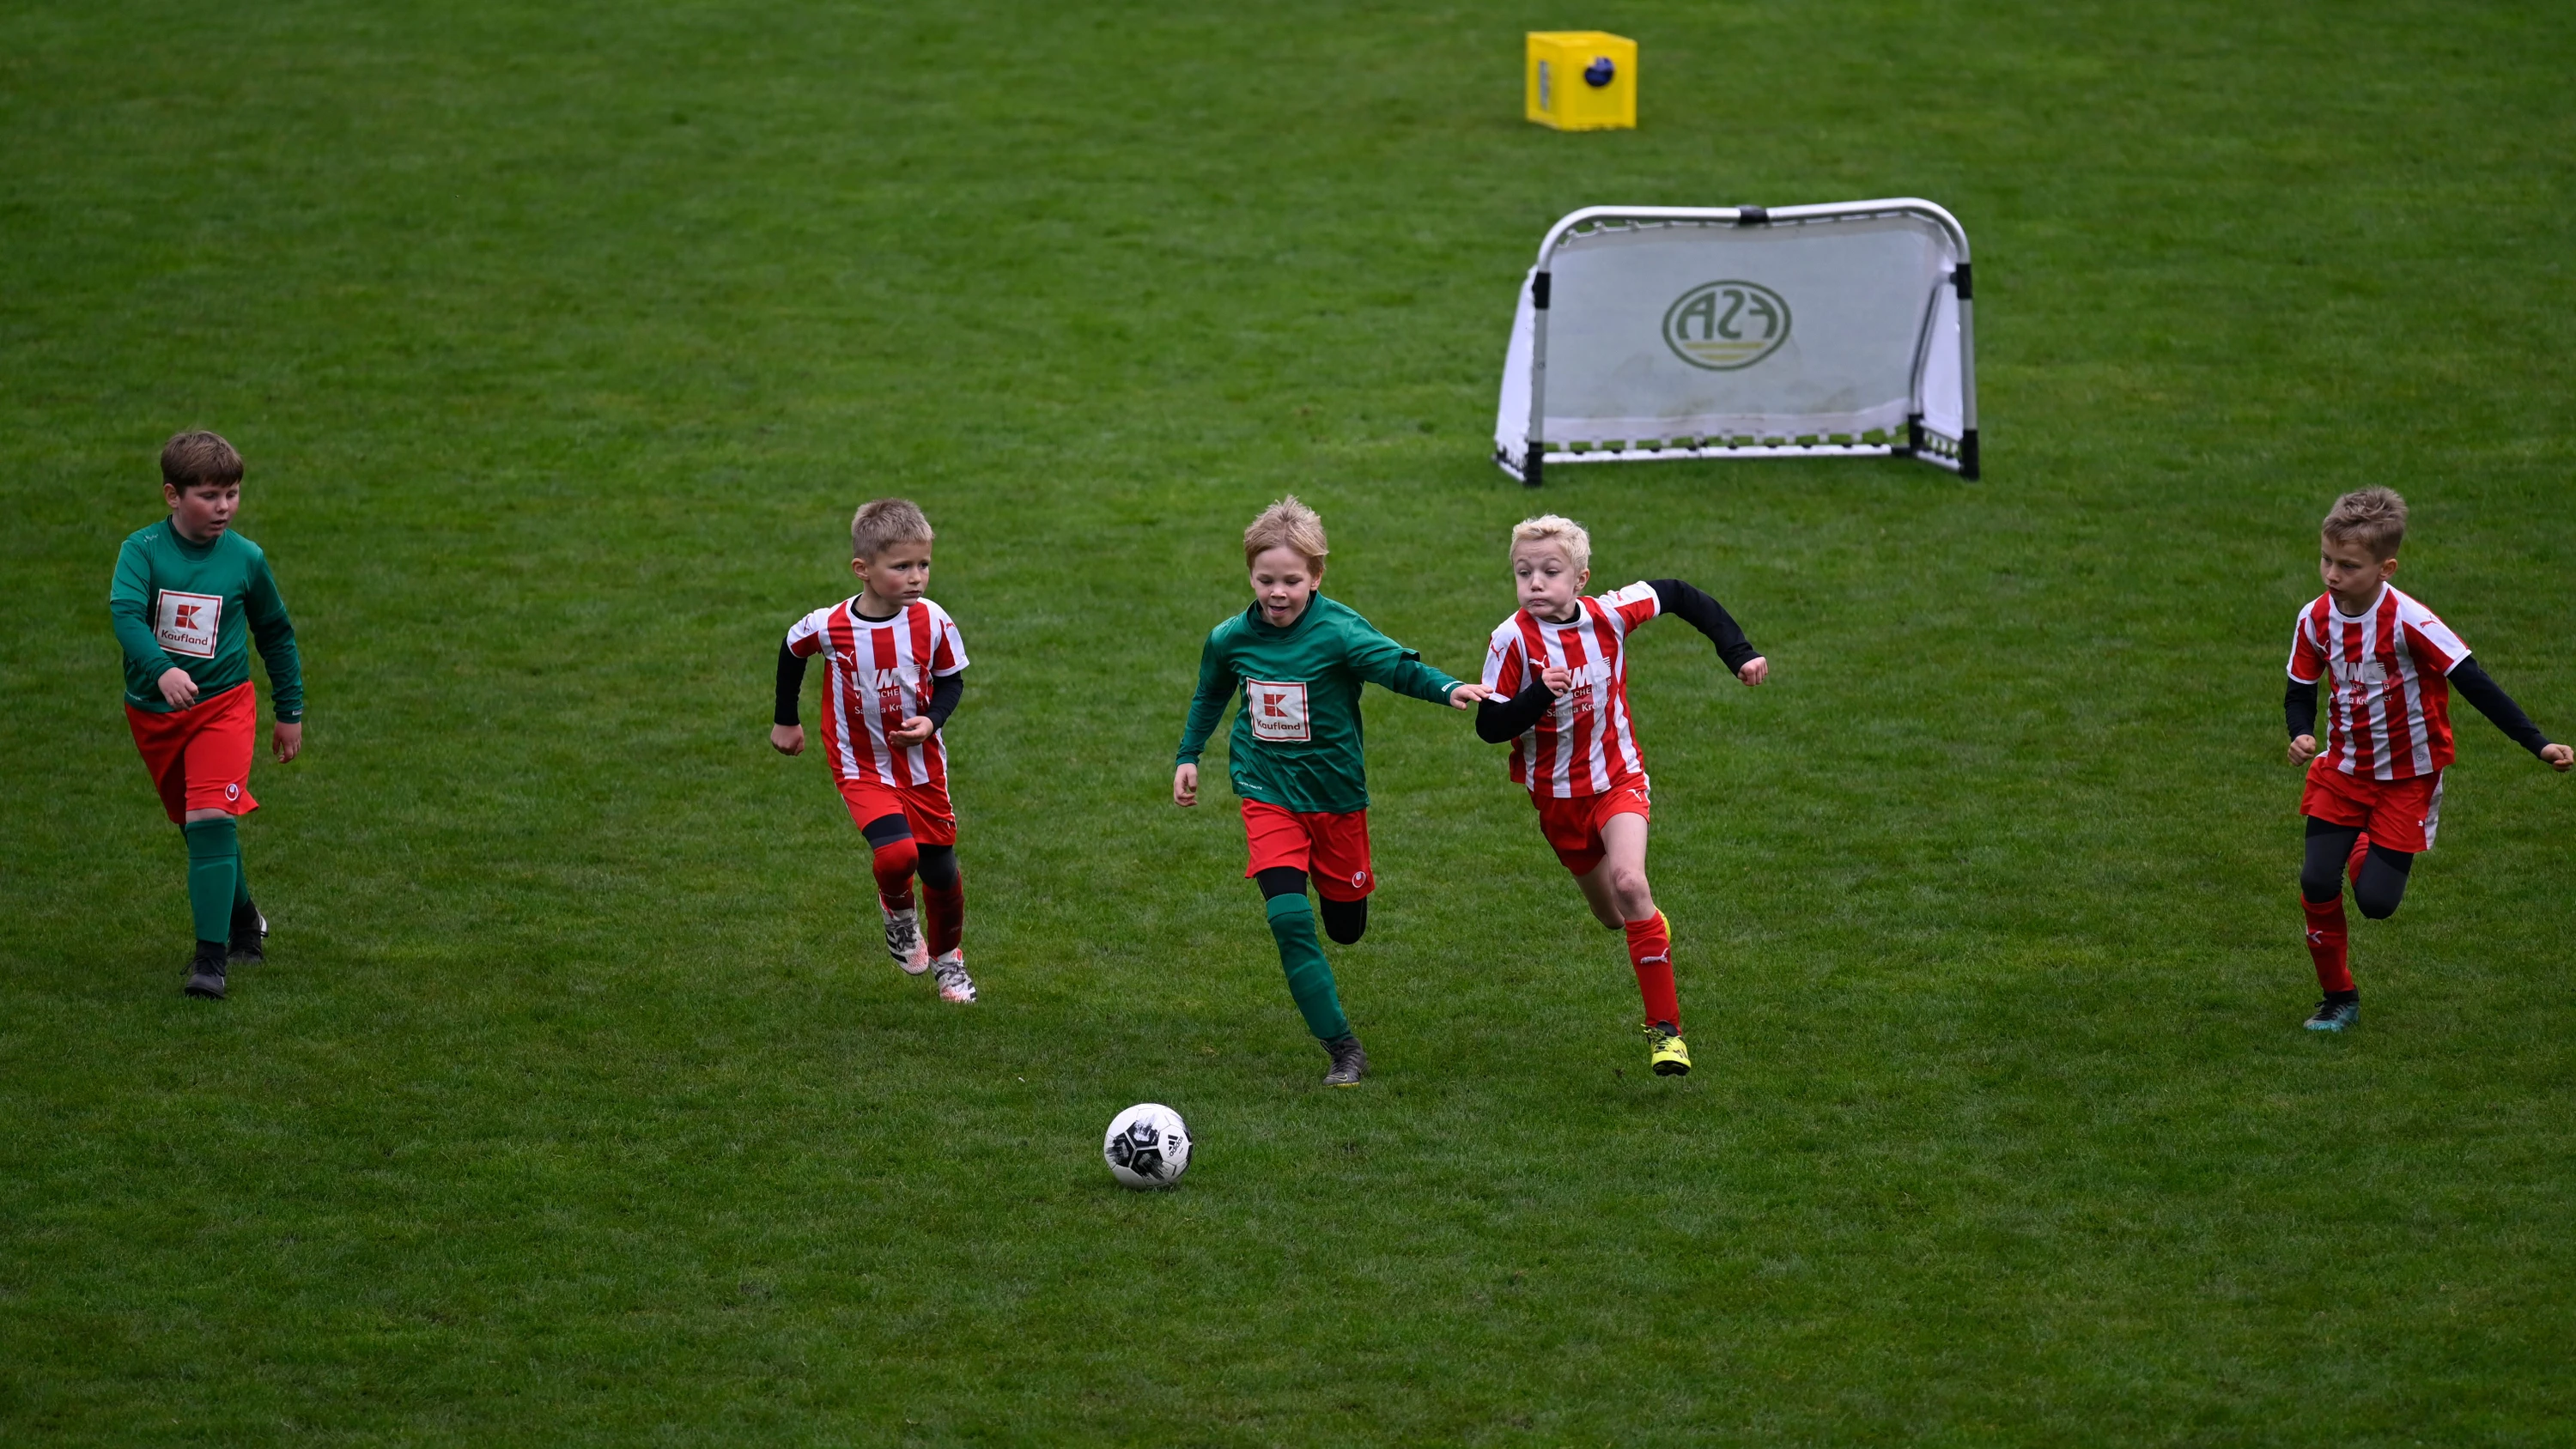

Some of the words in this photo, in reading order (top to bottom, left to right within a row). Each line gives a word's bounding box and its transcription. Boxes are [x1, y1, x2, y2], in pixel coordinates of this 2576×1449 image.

[161, 629, 208, 646] Kaufland
[1256, 718, 1301, 731] Kaufland
[1169, 1136, 1183, 1156] adidas
